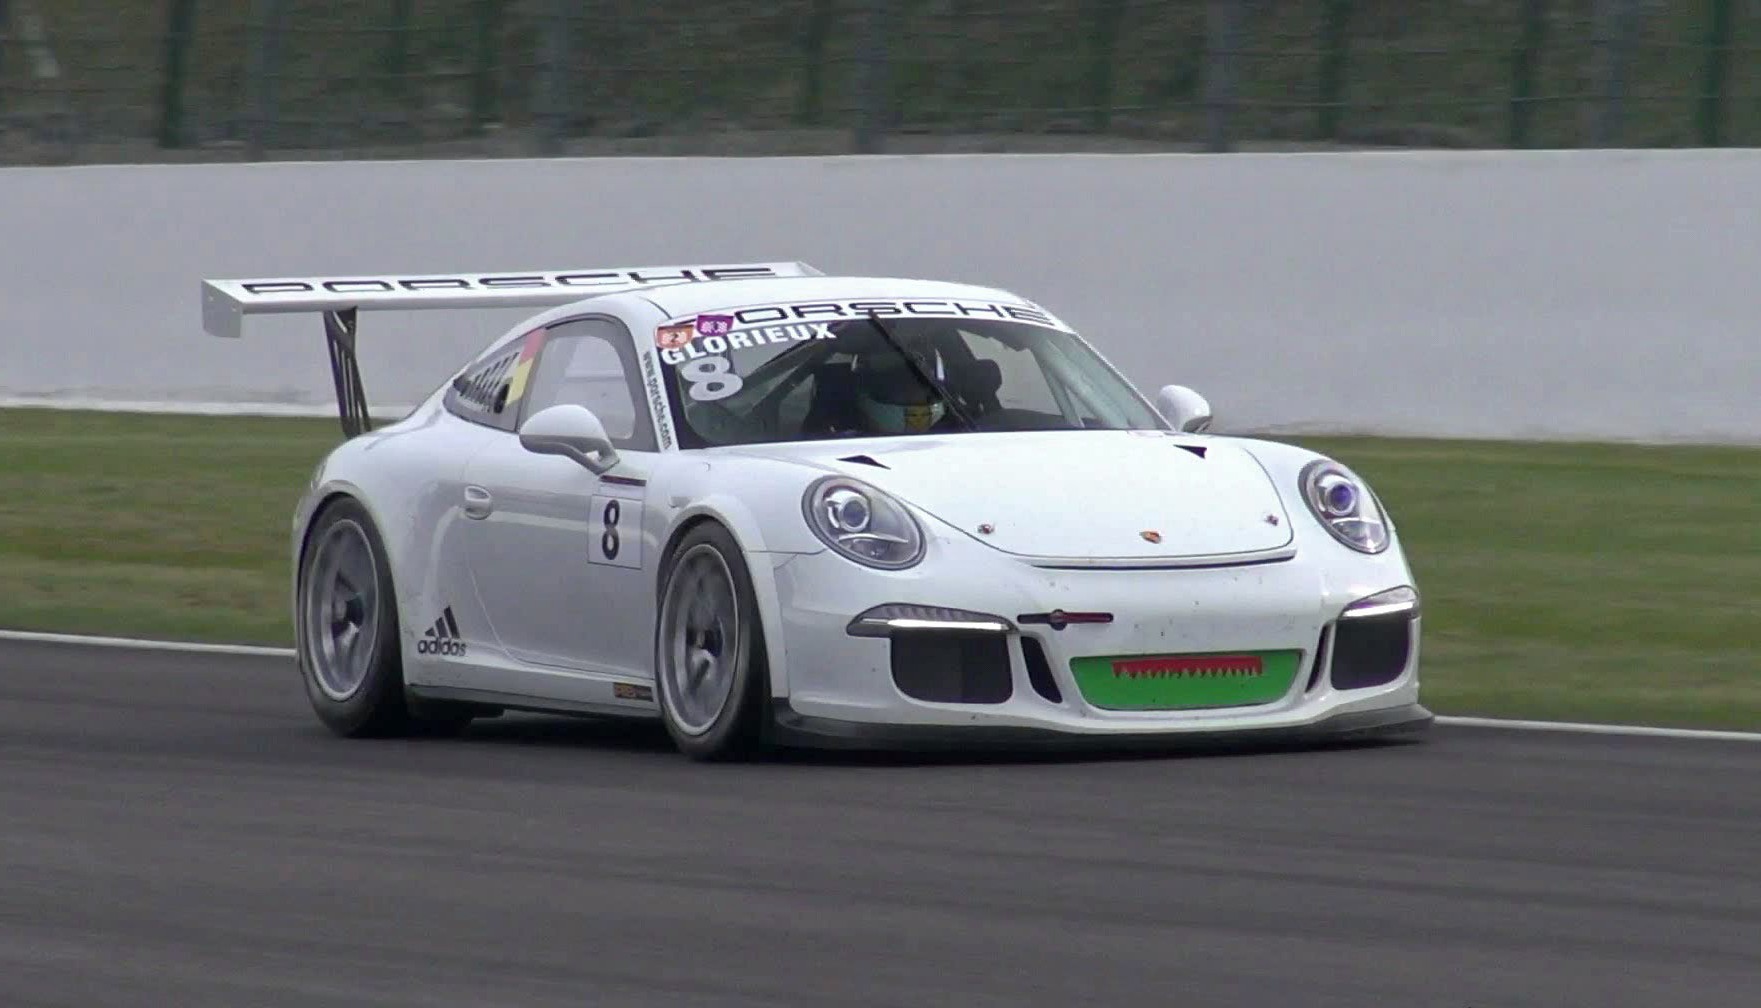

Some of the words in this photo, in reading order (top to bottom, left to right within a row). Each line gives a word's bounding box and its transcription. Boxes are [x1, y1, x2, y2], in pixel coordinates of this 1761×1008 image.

[241, 268, 776, 294] PORSCHE
[674, 302, 1056, 326] ORSCHE
[660, 322, 837, 366] GLORIEUX
[643, 351, 672, 450] www.porsche.com
[681, 356, 744, 401] 8
[602, 499, 620, 561] 8
[417, 636, 467, 657] adidas
